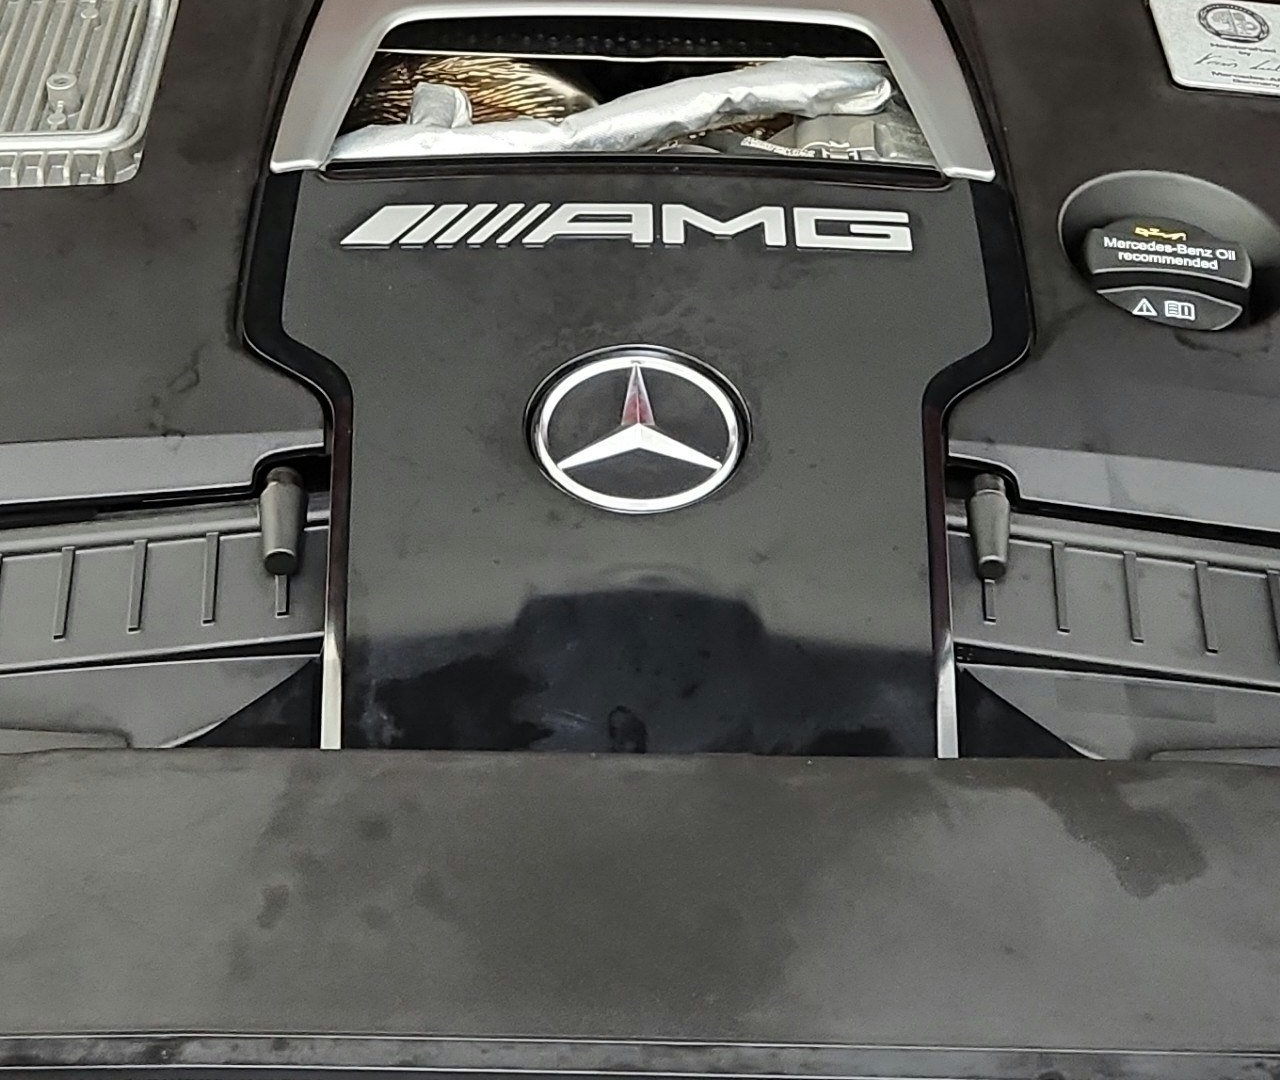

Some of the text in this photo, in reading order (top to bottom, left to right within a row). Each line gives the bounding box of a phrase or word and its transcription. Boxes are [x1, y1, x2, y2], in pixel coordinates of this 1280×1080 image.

[523, 202, 913, 252] AMG
[1103, 236, 1237, 261] Mercedes-Benz Oil
[1117, 250, 1219, 270] recommended
